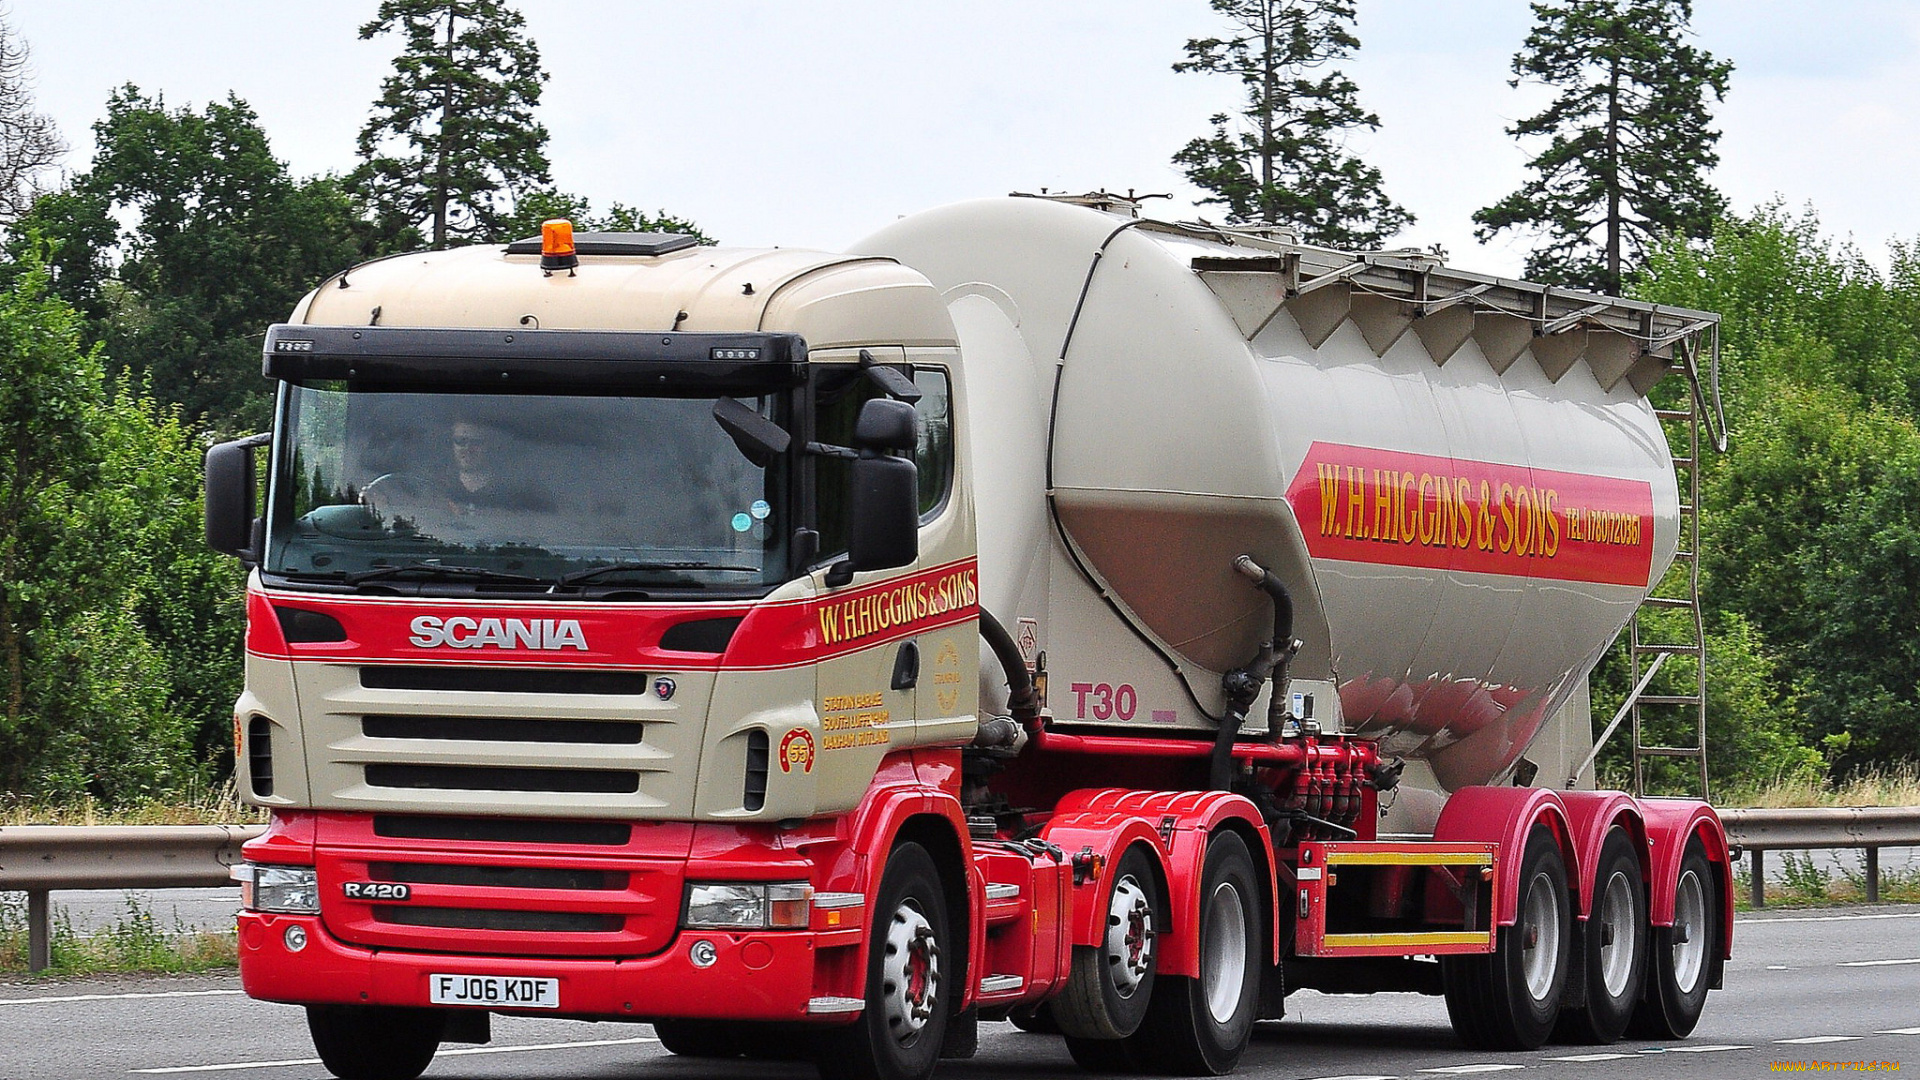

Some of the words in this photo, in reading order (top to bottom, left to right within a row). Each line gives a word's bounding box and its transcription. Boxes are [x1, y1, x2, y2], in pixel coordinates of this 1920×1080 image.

[1372, 468, 1473, 550] HIGGINS
[1476, 479, 1497, 553] &
[1499, 482, 1560, 559] SONS
[928, 586, 940, 616] &
[938, 569, 976, 612] SONS
[408, 615, 590, 651] SCANIA
[1071, 683, 1138, 722] T30
[823, 715, 851, 732] SOUTH
[790, 744, 808, 764] 55
[440, 977, 498, 1000] FJ06
[505, 980, 549, 1002] KDF
